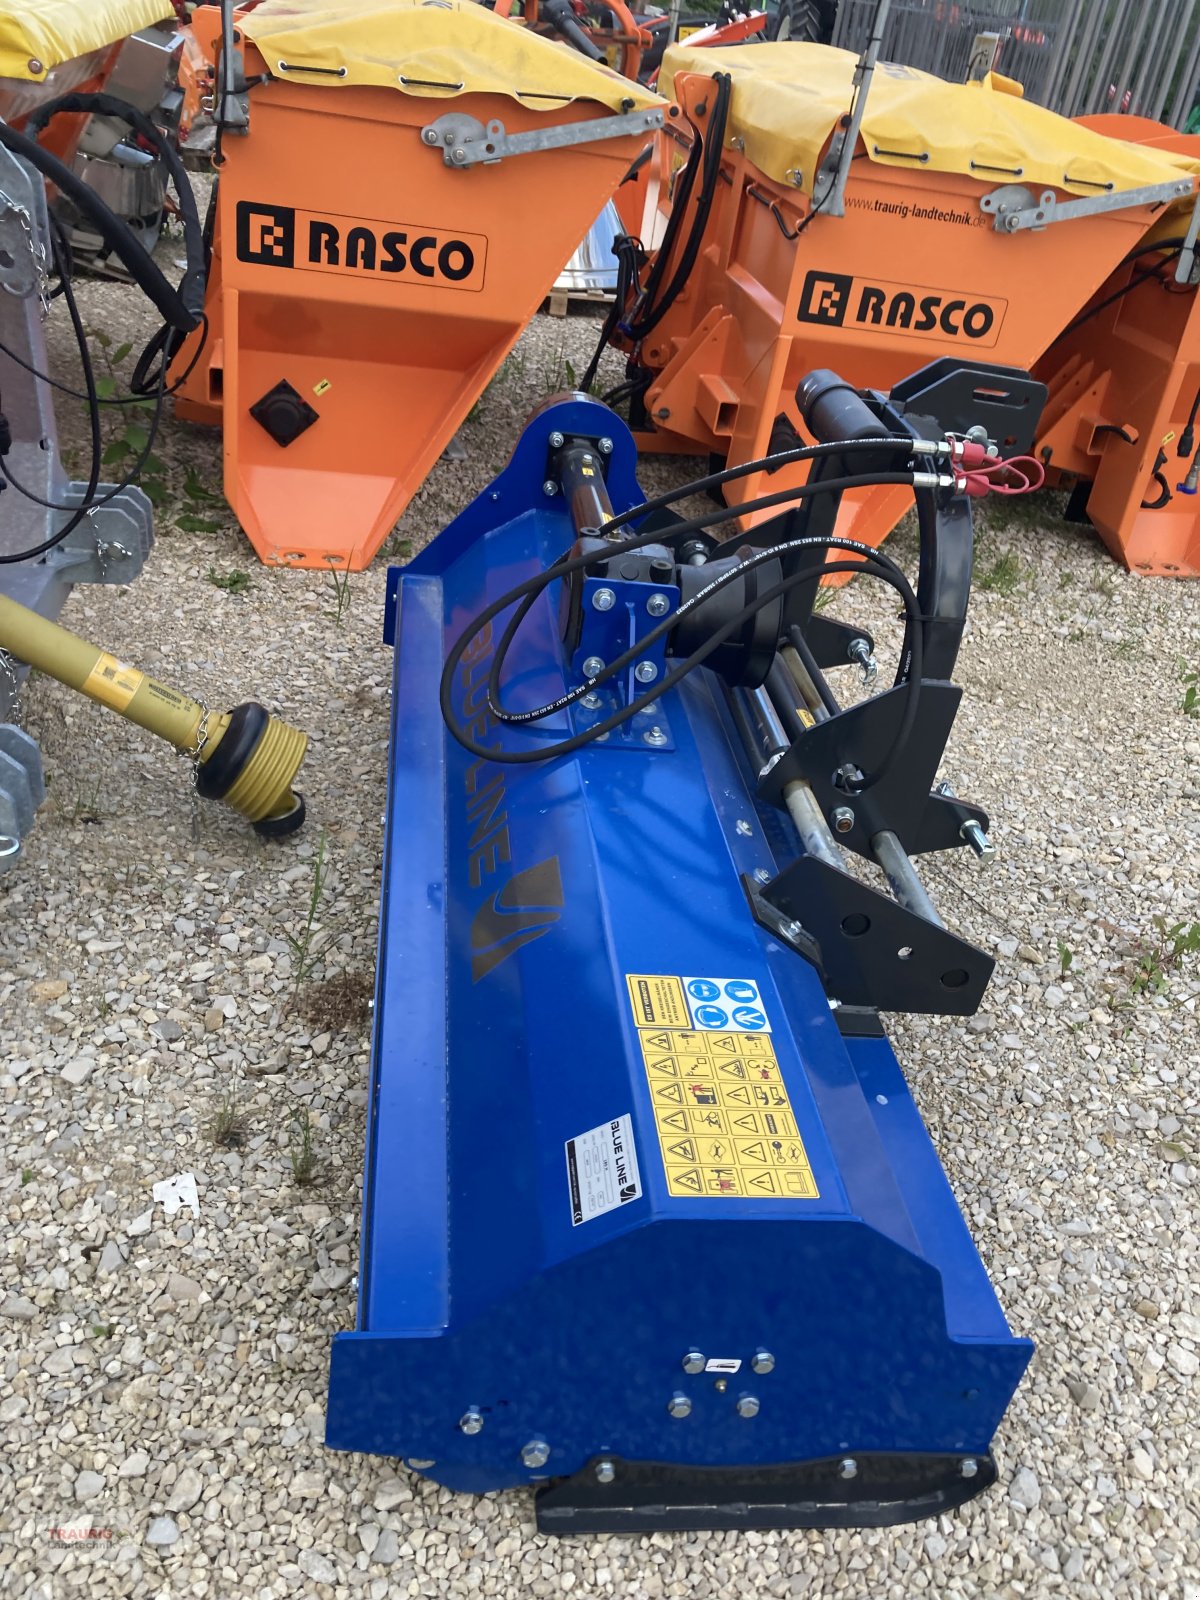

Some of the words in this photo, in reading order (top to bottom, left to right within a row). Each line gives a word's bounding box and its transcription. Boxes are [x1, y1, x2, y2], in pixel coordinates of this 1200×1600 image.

[844, 197, 986, 228] www.traurig-landtechnik.de
[308, 220, 475, 281] RASCO
[856, 286, 994, 339] RASCO
[853, 541, 866, 549] SAE
[459, 617, 502, 746] BLUE
[463, 741, 512, 888] LINE
[610, 1120, 623, 1155] BLUE
[615, 1156, 628, 1186] LINE
